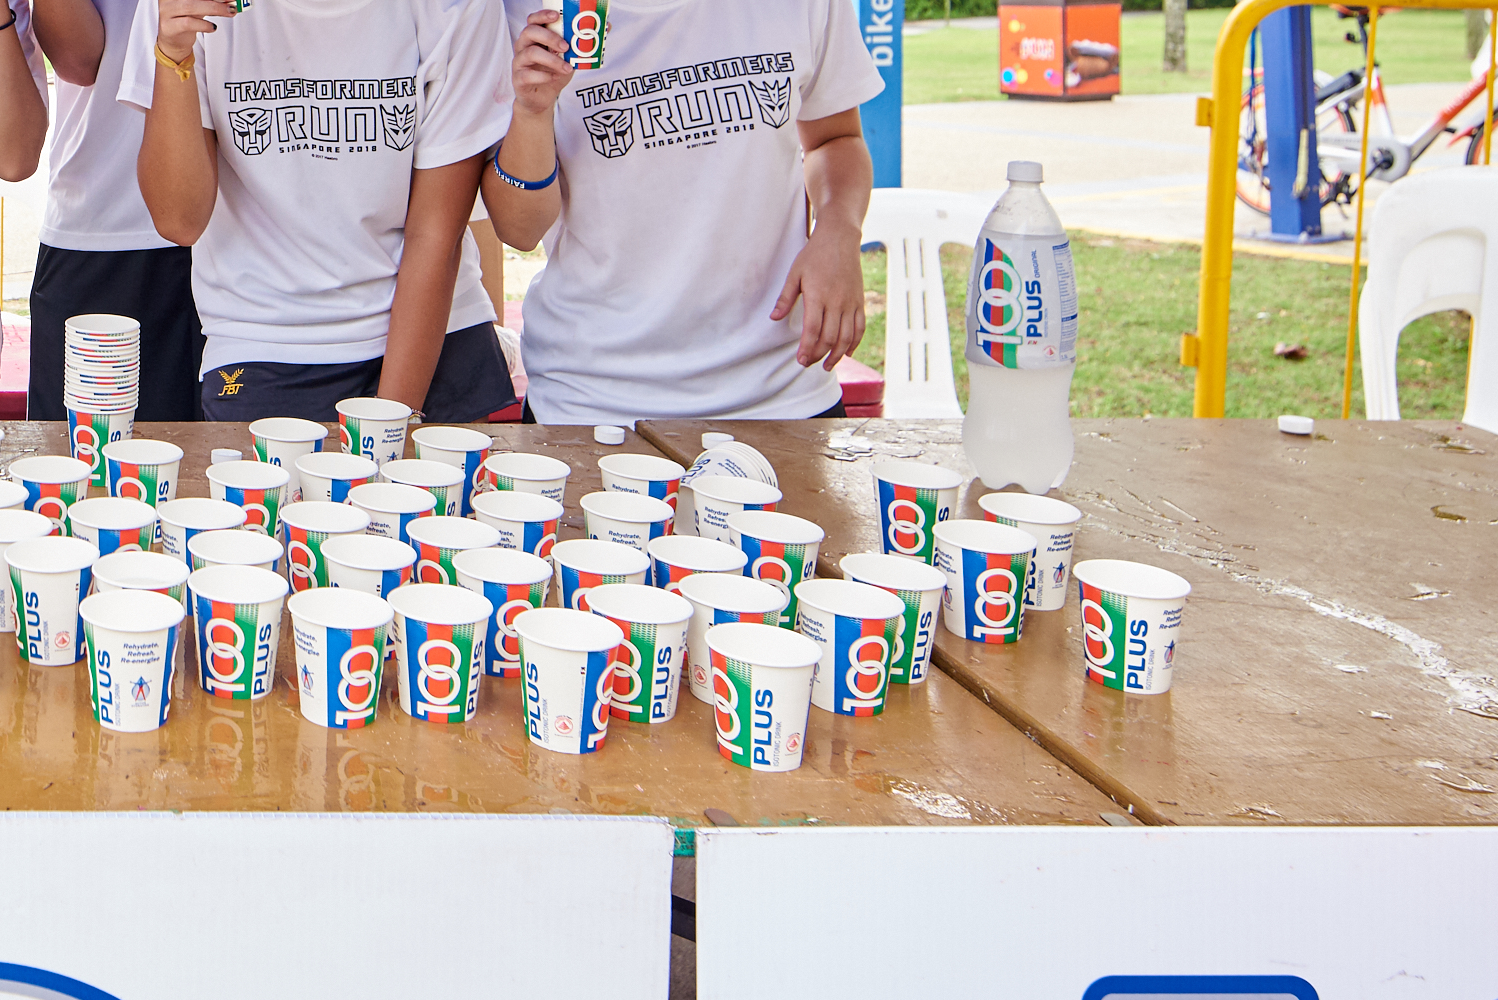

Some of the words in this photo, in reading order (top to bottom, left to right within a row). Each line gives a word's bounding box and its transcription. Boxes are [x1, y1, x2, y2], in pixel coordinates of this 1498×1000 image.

[570, 10, 601, 66] 100
[576, 52, 794, 108] TRANSFORMERS
[636, 83, 753, 139] RUN
[276, 105, 377, 143] RUN
[279, 144, 340, 154] SINGAPORE
[644, 128, 718, 150] SINGAPORE
[726, 123, 755, 134] 2018
[1030, 249, 1041, 279] ORIGINAL
[976, 260, 1023, 346] 100
[1026, 280, 1042, 337] PLUS
[218, 383, 243, 396] FBT
[608, 530, 641, 539] Rehydrate,
[612, 537, 637, 546] Refresh,
[887, 498, 926, 562] 100
[26, 591, 43, 660] PLUS
[492, 599, 534, 675] 100
[973, 568, 1018, 638] 100
[120, 656, 160, 665] Re-energise
[123, 642, 159, 651] Rehydrate,
[205, 618, 245, 692] 100
[253, 623, 272, 696] PLUS
[842, 635, 889, 712] 100
[911, 611, 933, 680] PLUS
[1081, 598, 1116, 679] 100
[1126, 619, 1148, 690] PLUS
[98, 650, 114, 725] PLUS
[335, 644, 379, 725] 100
[417, 639, 462, 717] 100
[466, 640, 483, 715] PLUS
[527, 661, 544, 741] PLUS
[587, 661, 617, 749] 100
[652, 646, 672, 718] PLUS
[711, 667, 744, 756] 100
[753, 689, 774, 766] PLUS
